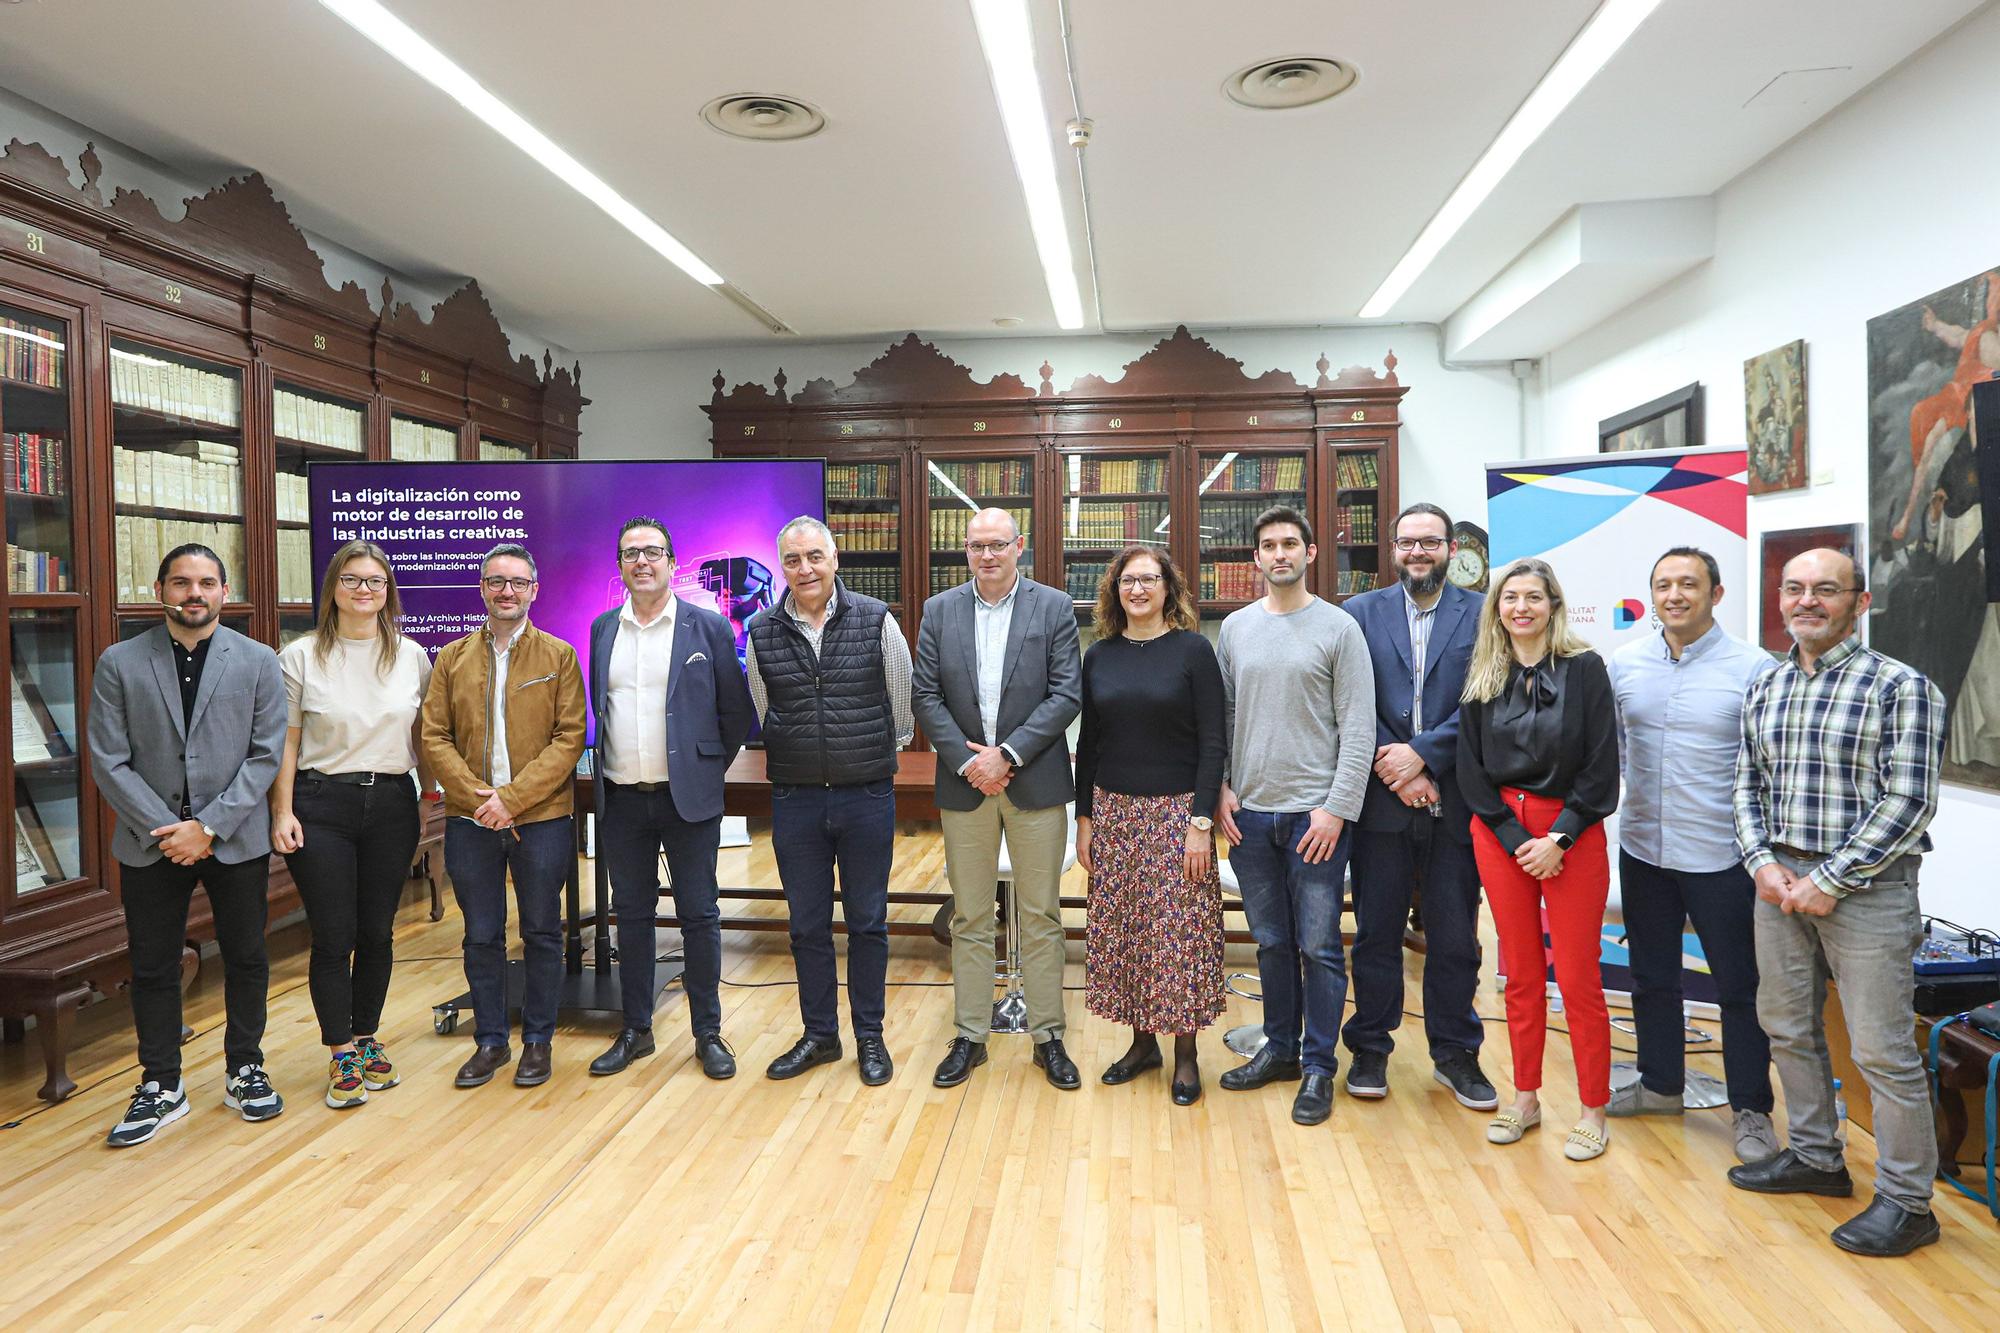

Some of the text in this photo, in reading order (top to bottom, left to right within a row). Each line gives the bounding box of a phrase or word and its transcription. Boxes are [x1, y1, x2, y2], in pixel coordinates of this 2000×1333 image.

[27, 232, 46, 255] 31
[165, 285, 182, 304] 32
[314, 334, 326, 350] 33
[420, 369, 430, 384] 34
[1247, 415, 1258, 426] 41
[1351, 411, 1365, 421] 42
[973, 421, 986, 432] 39
[1108, 418, 1122, 429] 40
[744, 426, 756, 436] 37
[841, 425, 853, 435] 38
[331, 487, 522, 506] La digitalización como
[332, 506, 524, 522] motor de desarrollo de
[333, 525, 529, 541] las industrias creativas.
[392, 552, 418, 561] sobre
[420, 552, 433, 560] las
[397, 562, 466, 571] modernización
[1567, 606, 1597, 615] ALITAT
[419, 616, 425, 624] y
[426, 614, 461, 623] Archivo
[463, 613, 489, 622] Histór
[437, 624, 462, 633] Plaza
